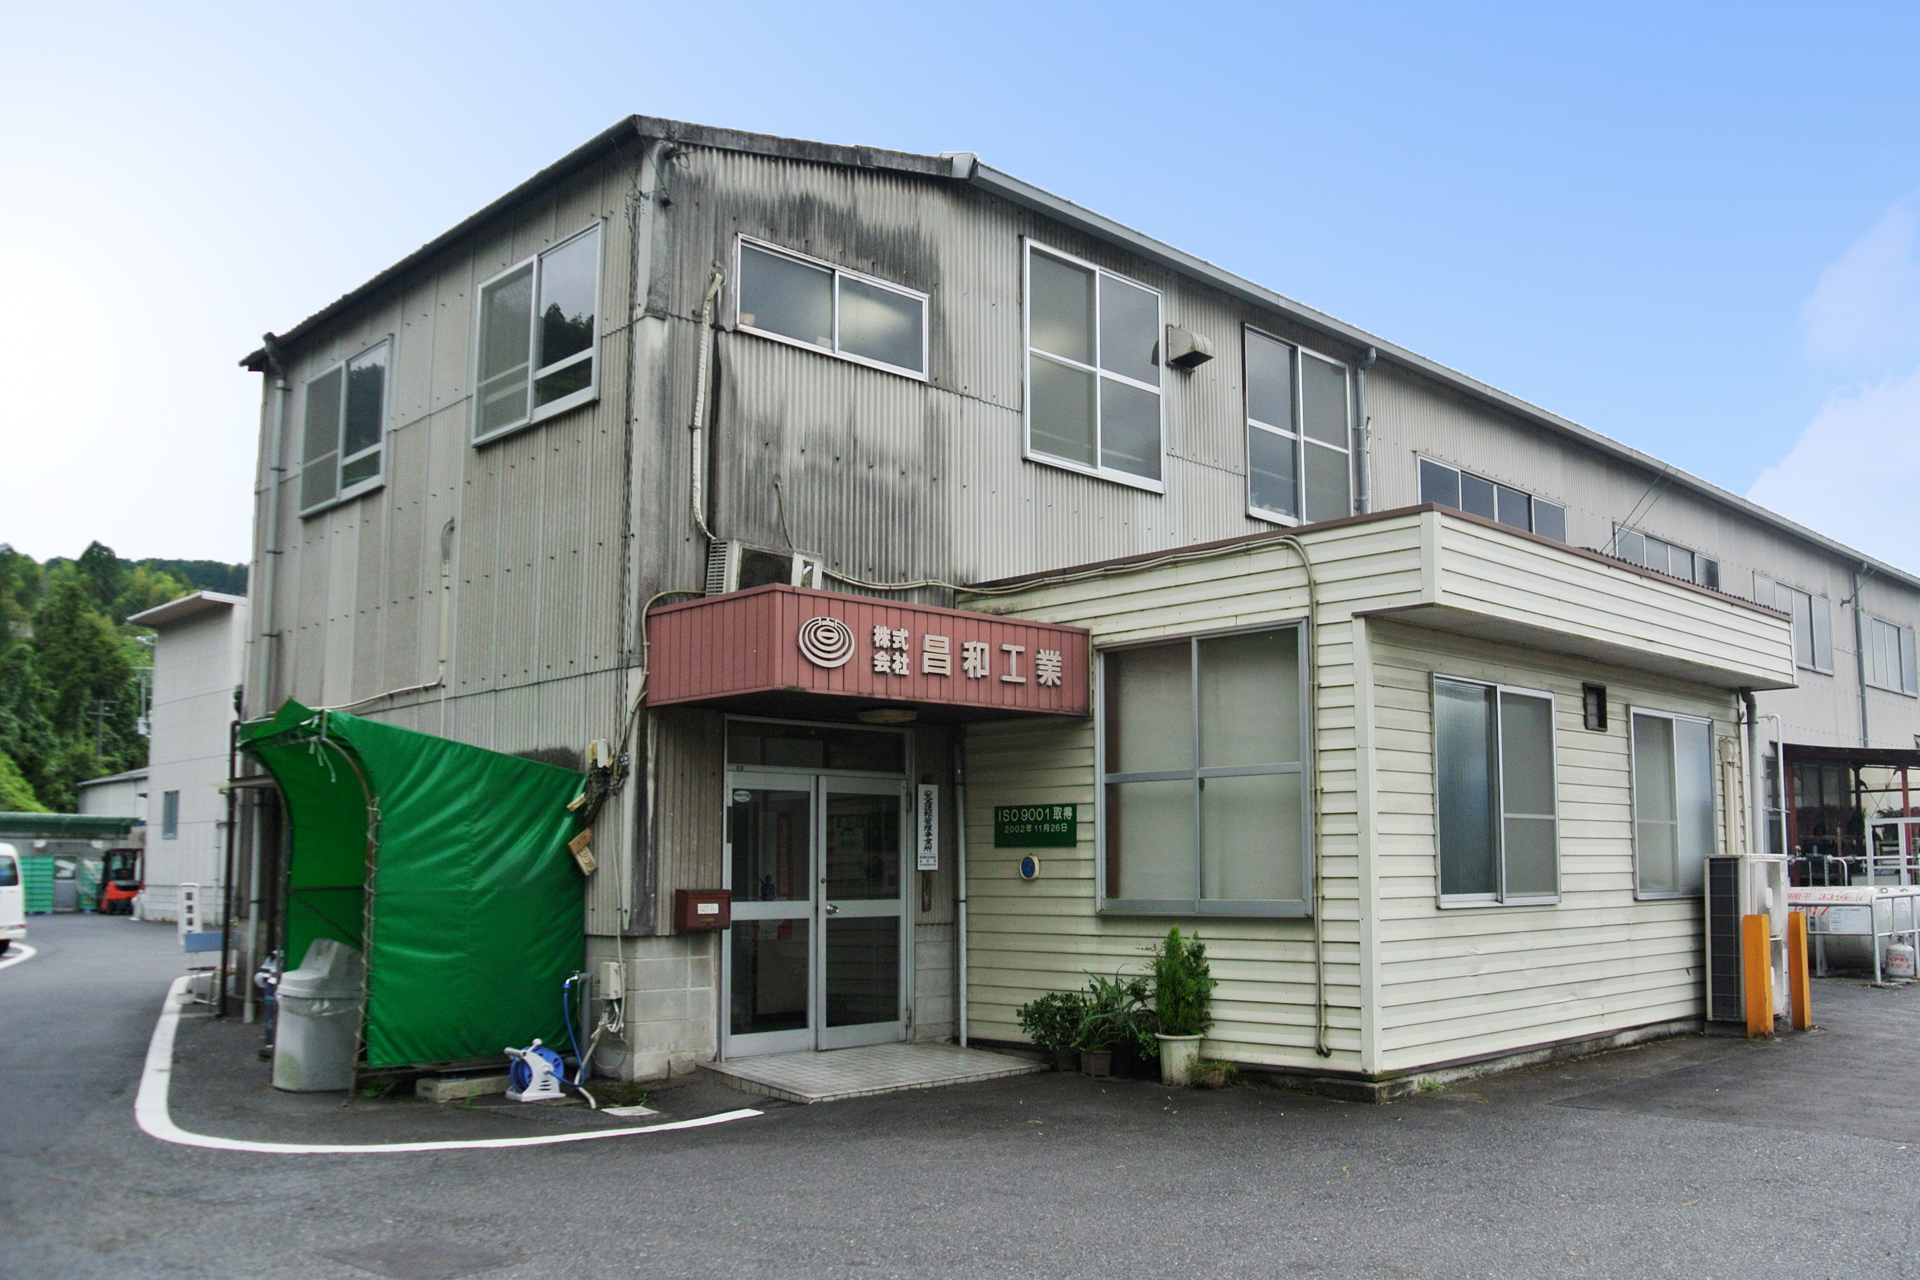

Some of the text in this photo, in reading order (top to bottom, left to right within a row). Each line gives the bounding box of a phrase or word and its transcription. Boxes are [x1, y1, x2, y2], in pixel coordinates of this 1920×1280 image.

[873, 625, 909, 650] 株式
[873, 650, 910, 676] 会社
[922, 634, 1062, 687] 昌和工業
